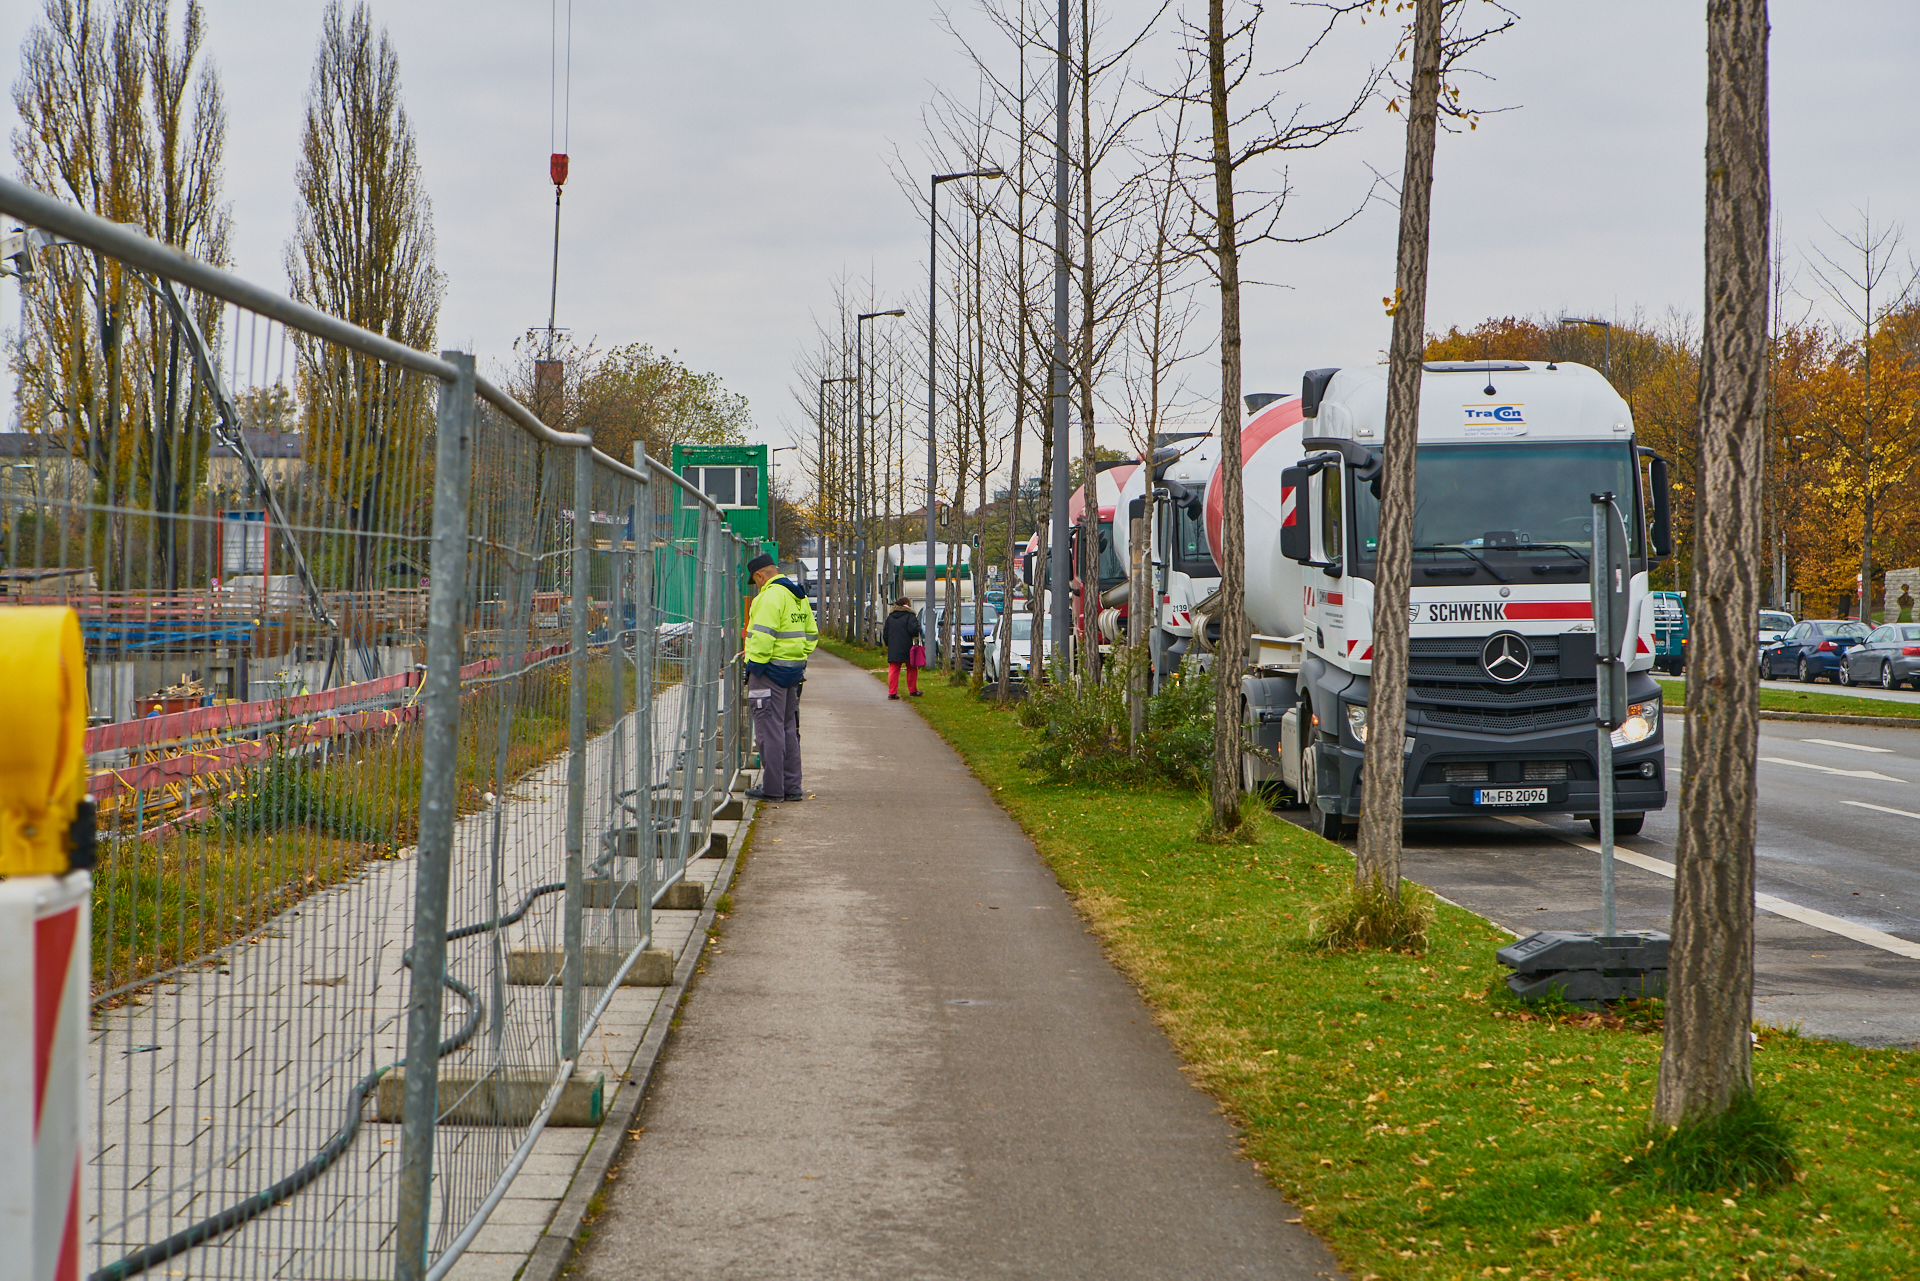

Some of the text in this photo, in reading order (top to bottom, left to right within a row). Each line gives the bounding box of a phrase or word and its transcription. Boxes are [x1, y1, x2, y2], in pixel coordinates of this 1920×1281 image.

[1464, 406, 1524, 422] TraCon
[1172, 604, 1188, 613] 2139
[1429, 603, 1505, 622] SCHWENK
[1481, 789, 1546, 802] M FB 2096
